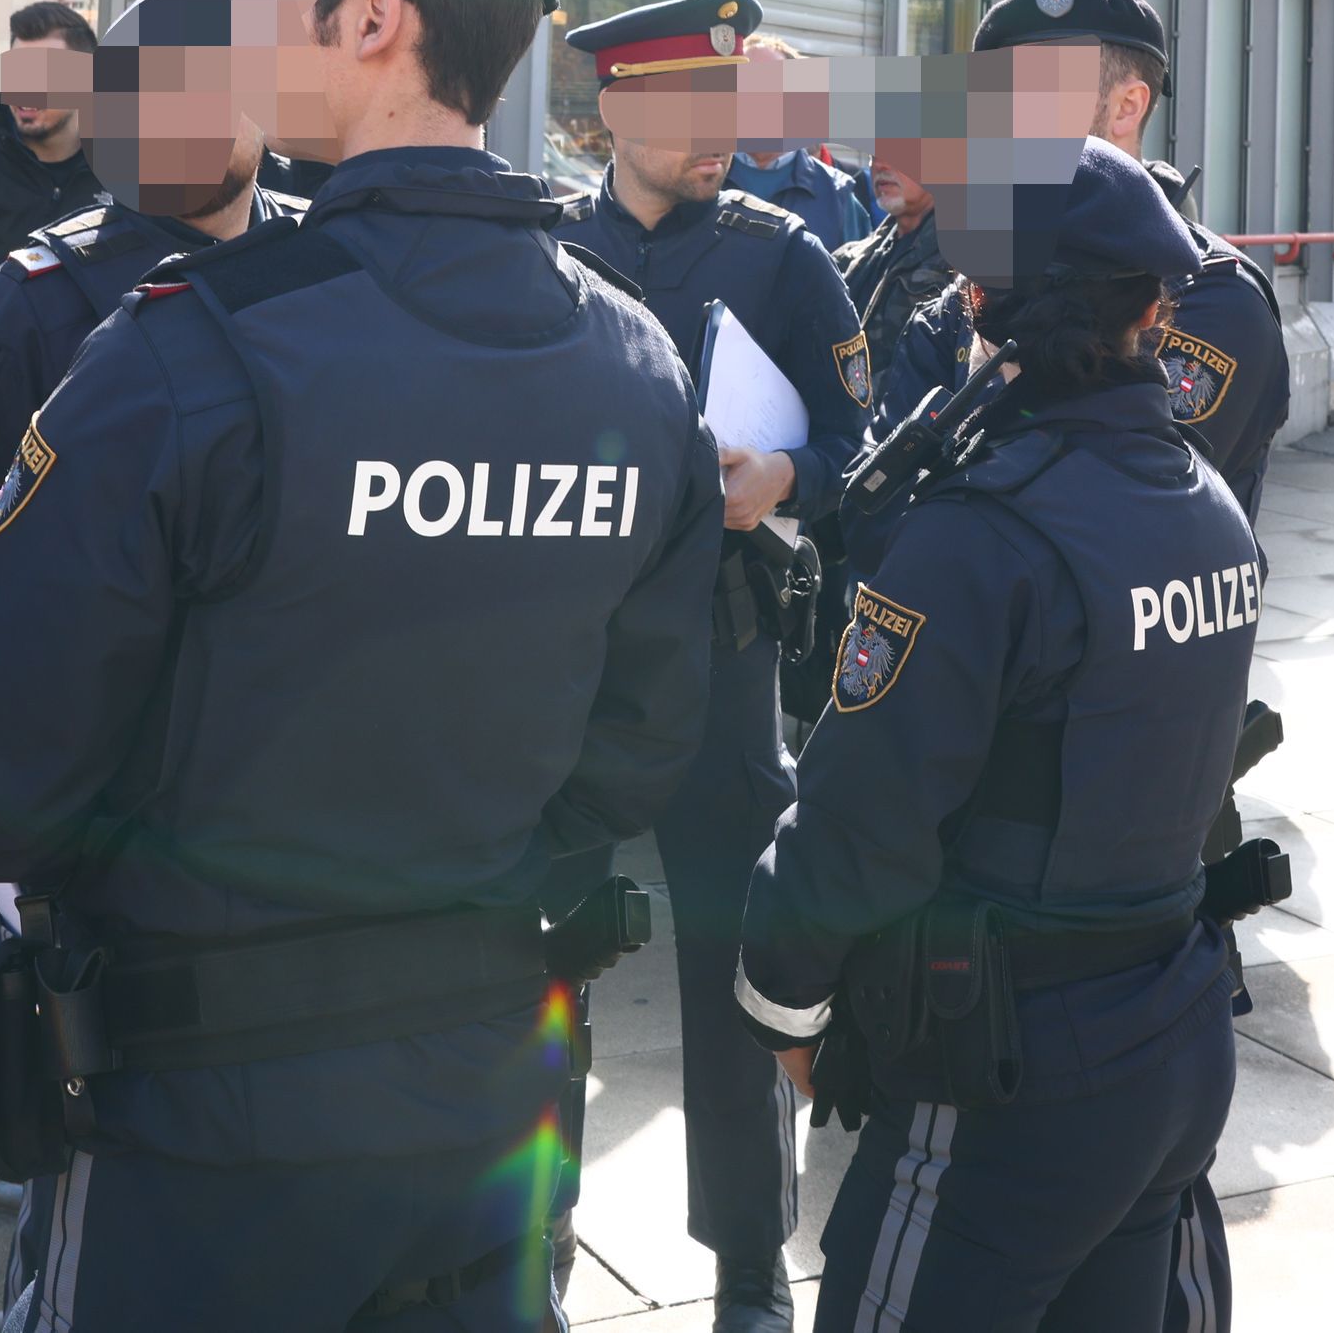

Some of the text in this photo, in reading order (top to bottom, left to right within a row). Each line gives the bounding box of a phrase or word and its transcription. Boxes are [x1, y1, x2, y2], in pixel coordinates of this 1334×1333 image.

[1168, 335, 1230, 377] POLIZEI
[347, 460, 639, 537] POLIZEI
[857, 594, 913, 638] POLIZEI
